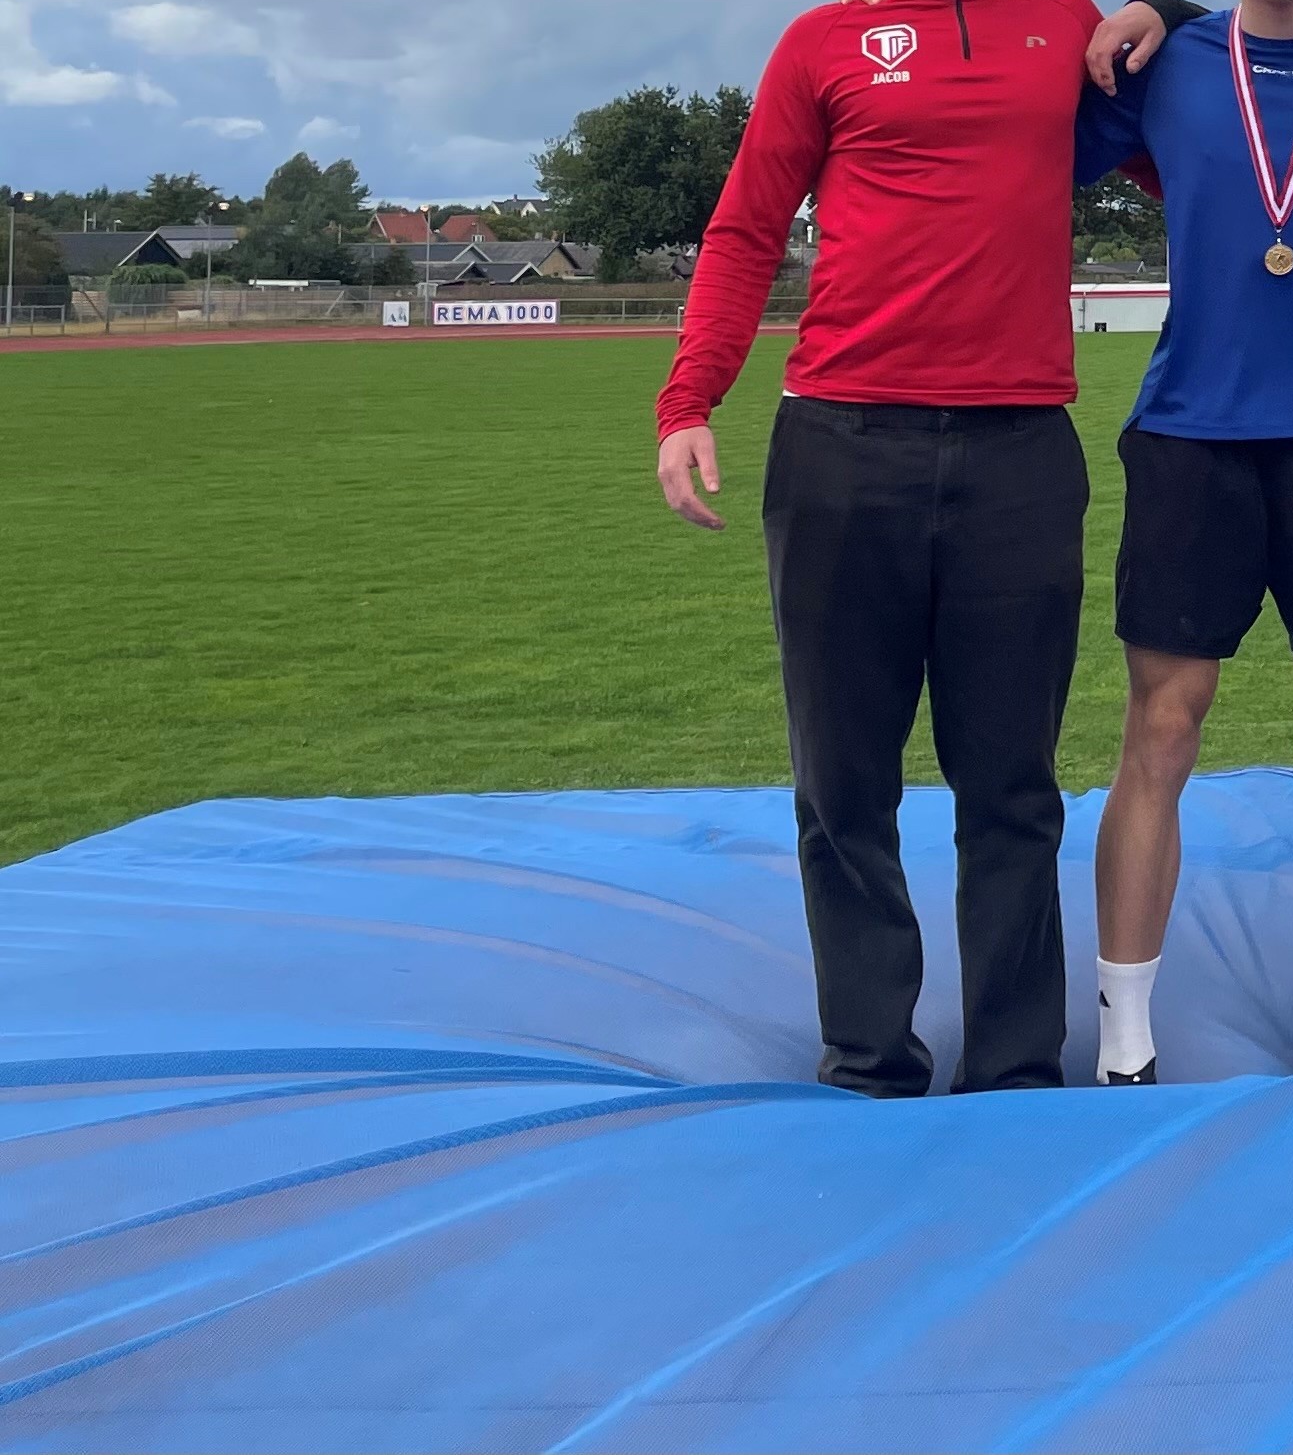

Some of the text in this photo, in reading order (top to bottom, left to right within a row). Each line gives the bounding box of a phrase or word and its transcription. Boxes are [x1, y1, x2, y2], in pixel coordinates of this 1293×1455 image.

[869, 30, 911, 62] TIF
[870, 71, 911, 85] JACOB
[437, 305, 553, 321] REMA 1000
